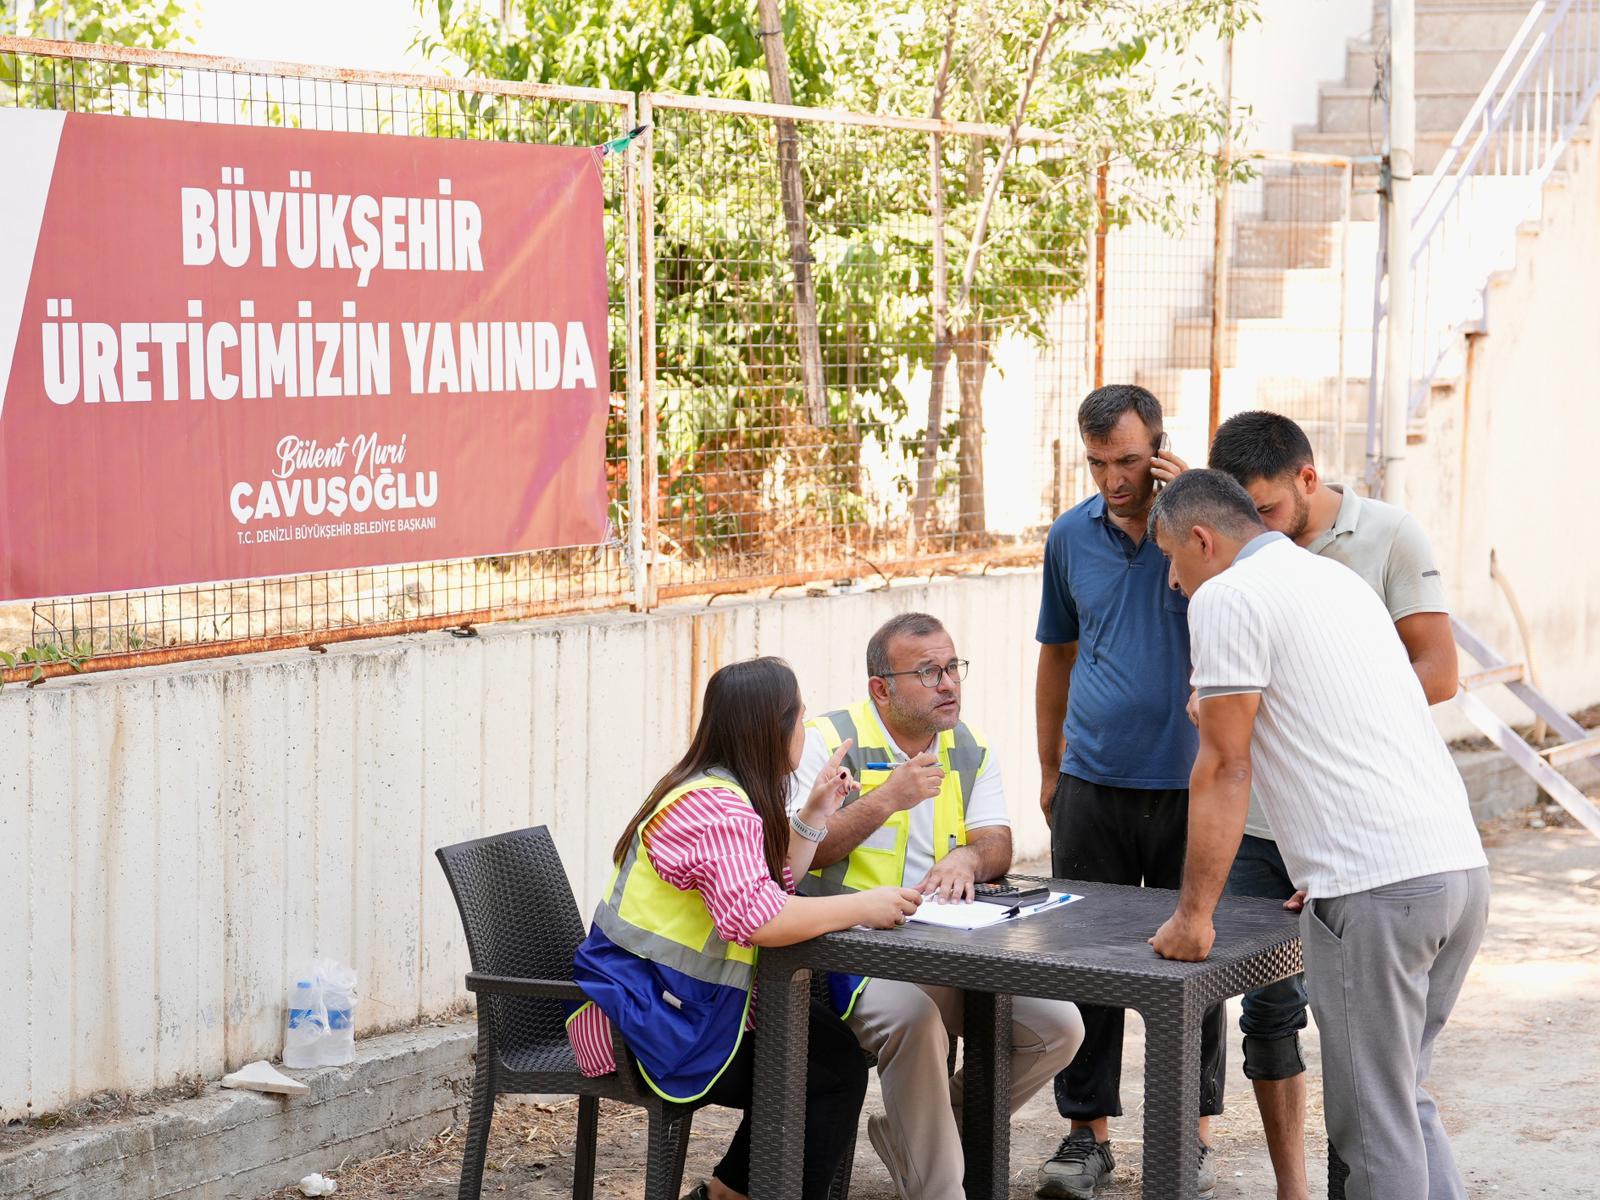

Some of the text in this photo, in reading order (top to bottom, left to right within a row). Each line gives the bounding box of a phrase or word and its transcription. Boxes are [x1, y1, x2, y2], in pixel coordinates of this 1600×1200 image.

[181, 167, 484, 287] BÜYÜKŞEHİR
[42, 299, 597, 405] ÜRETİCİMİZİN YANINDA
[272, 432, 407, 479] Bülent Nuri
[230, 468, 438, 524] ÇAVUŞOĞLU
[237, 516, 436, 544] T.C. DENİZLİ BÜYÜKŞEHİR BELEDİYE BAŞKANI
